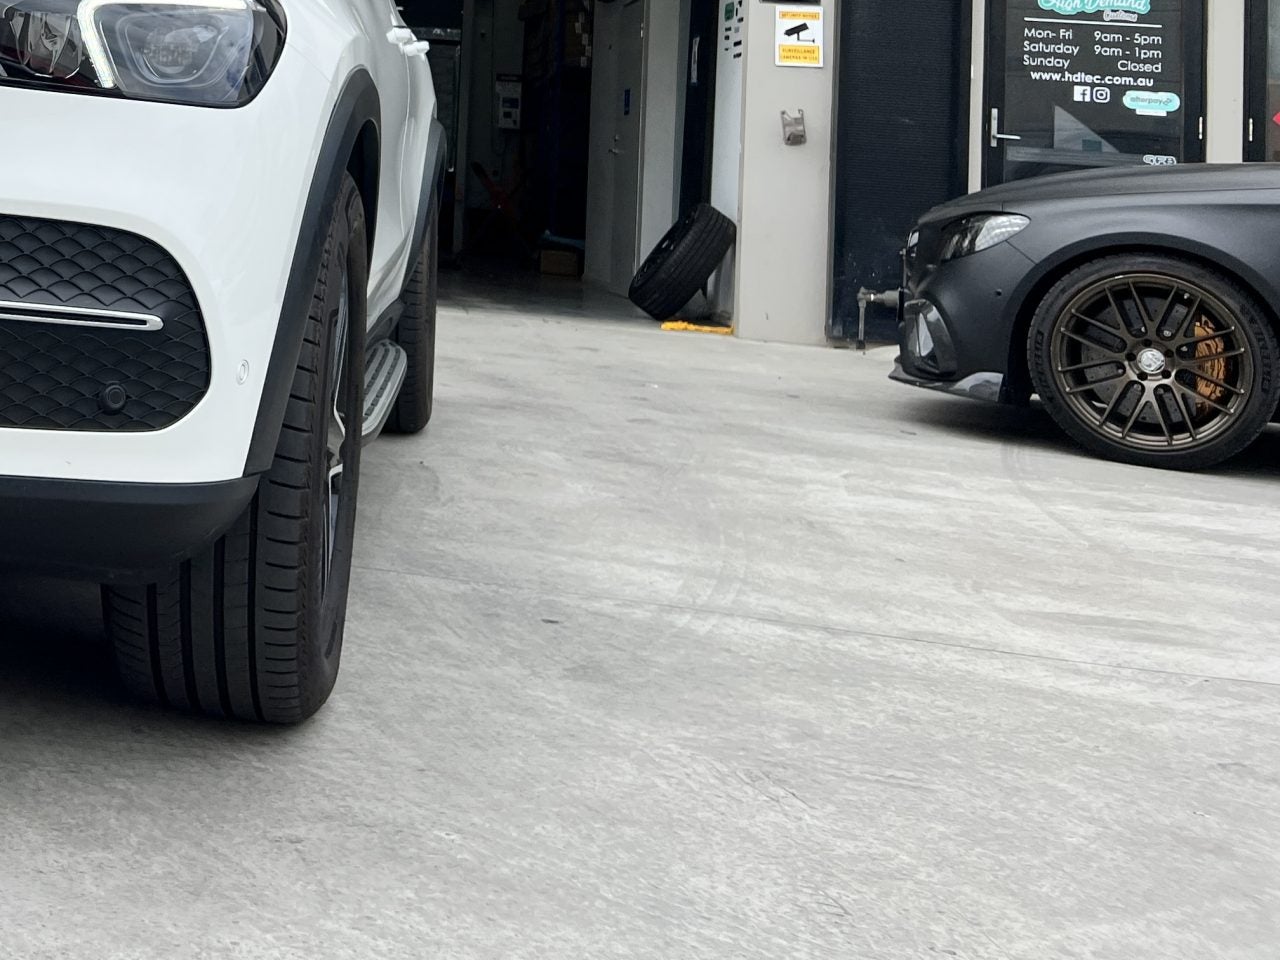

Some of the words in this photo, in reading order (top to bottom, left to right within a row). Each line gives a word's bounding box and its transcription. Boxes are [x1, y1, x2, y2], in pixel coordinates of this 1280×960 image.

[1093, 30, 1123, 43] 9am
[1133, 33, 1162, 46] 5pm
[1023, 41, 1080, 57] Saturday
[1093, 45, 1123, 57] 9am
[1134, 47, 1162, 59] 1pm
[1023, 54, 1071, 69] Sunday
[1117, 60, 1162, 73] Closed
[1030, 71, 1154, 87] www.hdtec.com.au
